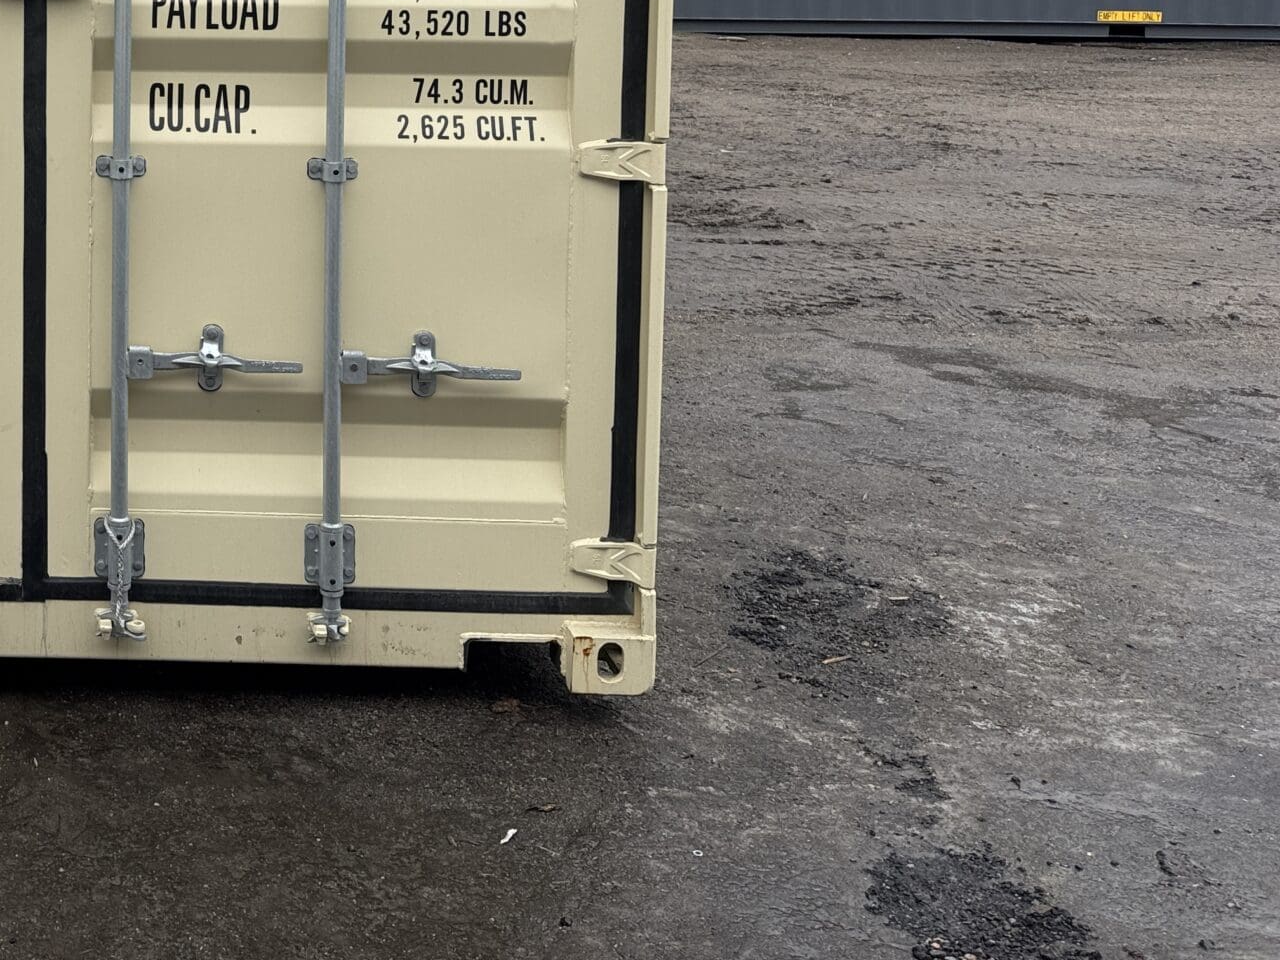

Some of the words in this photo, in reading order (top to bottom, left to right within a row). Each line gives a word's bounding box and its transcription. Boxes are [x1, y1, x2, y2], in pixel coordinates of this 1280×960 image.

[381, 9, 470, 39] 43,520
[484, 10, 527, 37] LBS
[413, 77, 464, 105] 74.3
[474, 78, 534, 106] CU.M.
[148, 82, 258, 135] CU.CAP.
[396, 114, 465, 143] 2,625
[476, 115, 546, 142] CU.FT.
